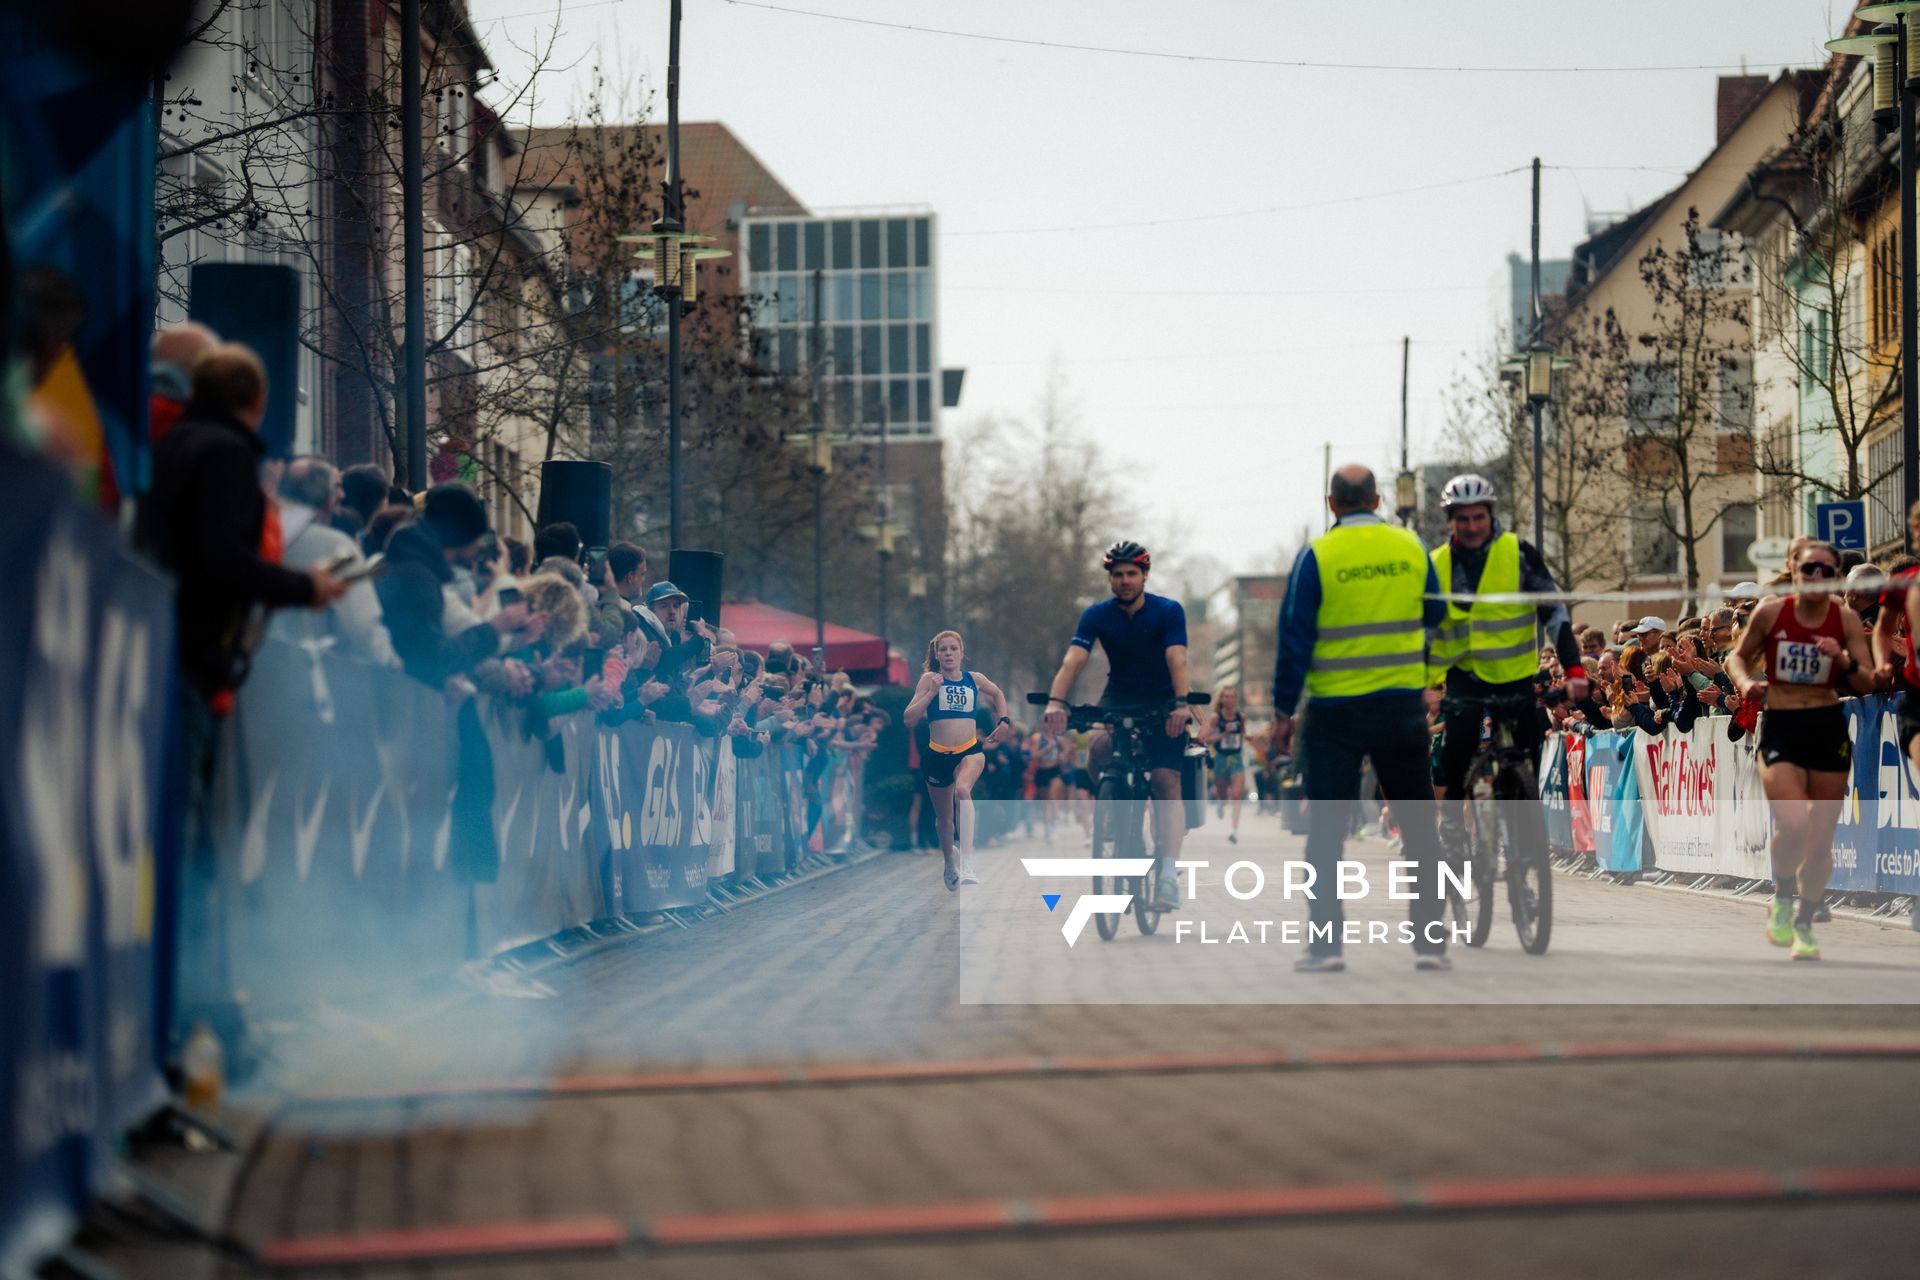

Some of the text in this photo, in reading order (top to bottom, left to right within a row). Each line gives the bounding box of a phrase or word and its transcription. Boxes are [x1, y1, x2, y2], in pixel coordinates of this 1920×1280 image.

[1828, 509, 1853, 544] P
[1336, 561, 1410, 584] ORDNER
[1788, 645, 1819, 658] GLS
[945, 686, 966, 695] GLS
[946, 695, 967, 705] 930
[1903, 850, 1912, 876] to
